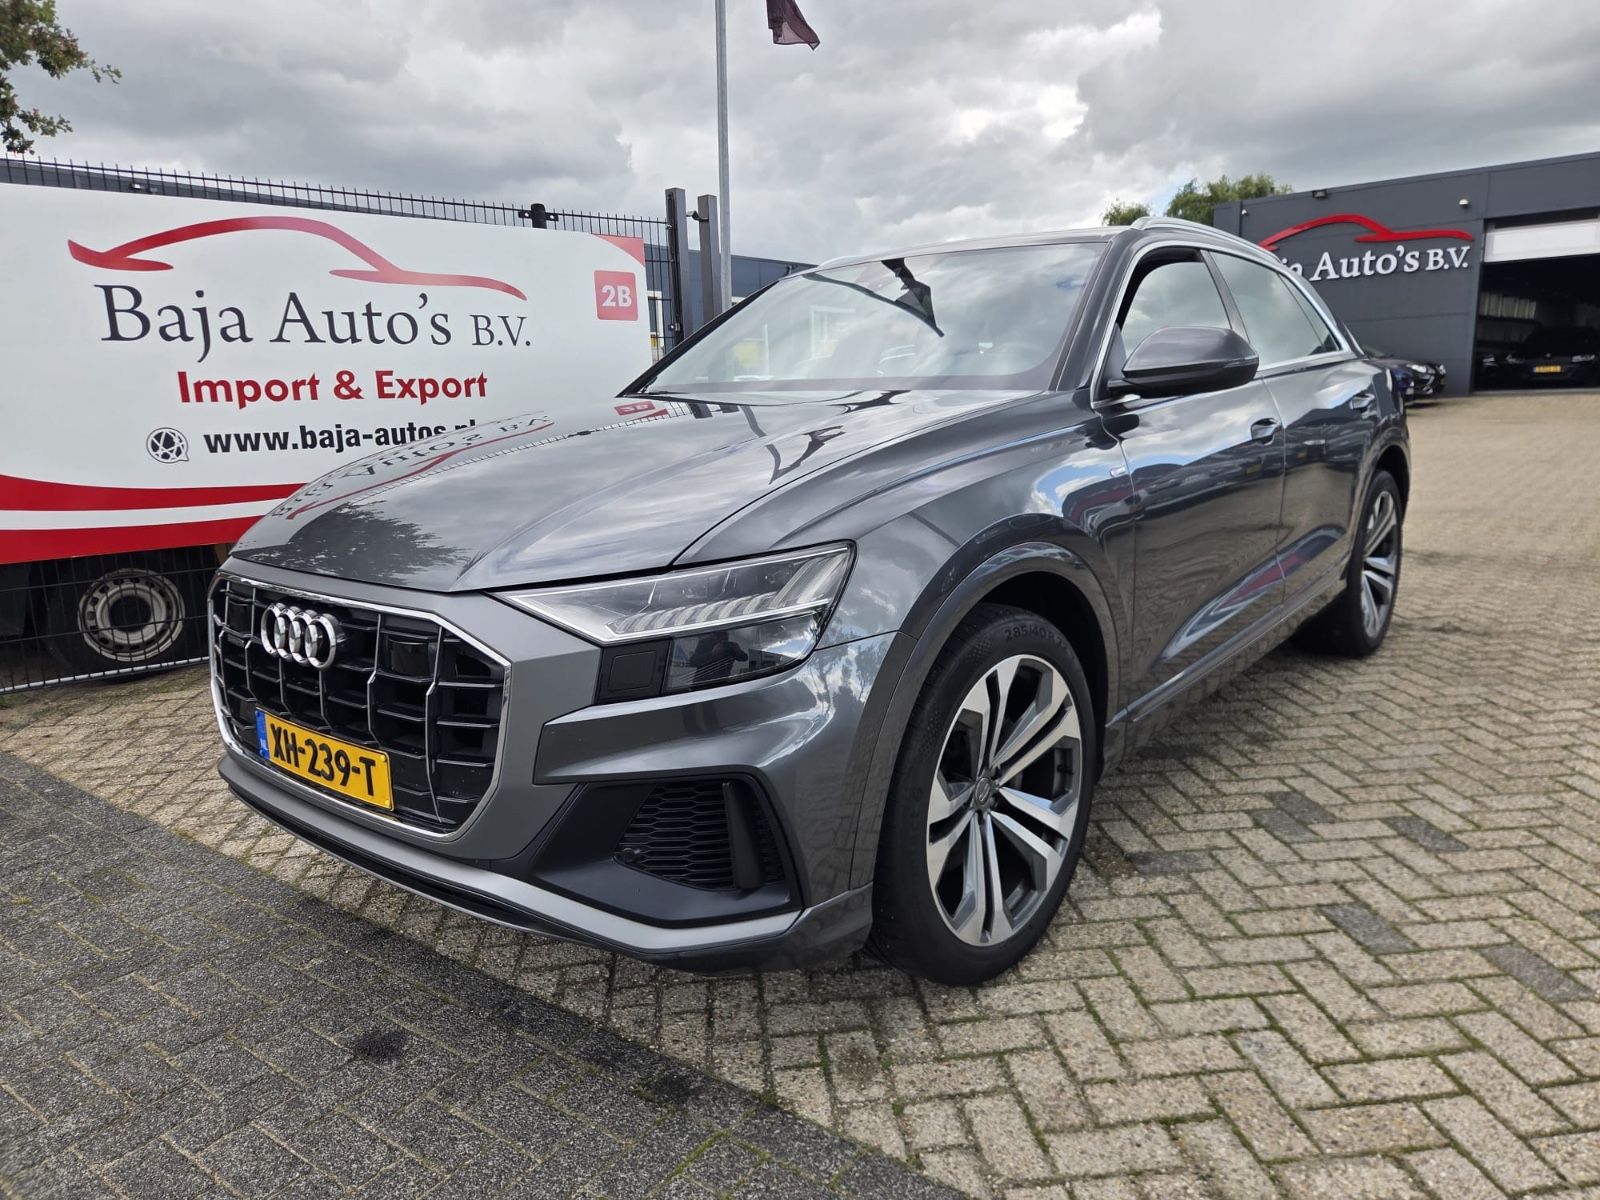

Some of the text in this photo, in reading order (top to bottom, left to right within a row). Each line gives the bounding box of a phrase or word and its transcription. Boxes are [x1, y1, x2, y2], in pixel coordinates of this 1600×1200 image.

[1309, 245, 1420, 281] Auto's
[1425, 245, 1471, 271] B.V.
[601, 284, 632, 307] 2B
[93, 284, 532, 363] Baja Auto's B.V.
[177, 370, 488, 410] Import & Export
[203, 418, 476, 454] www.baja-autos
[270, 722, 376, 797] XH-239-T
